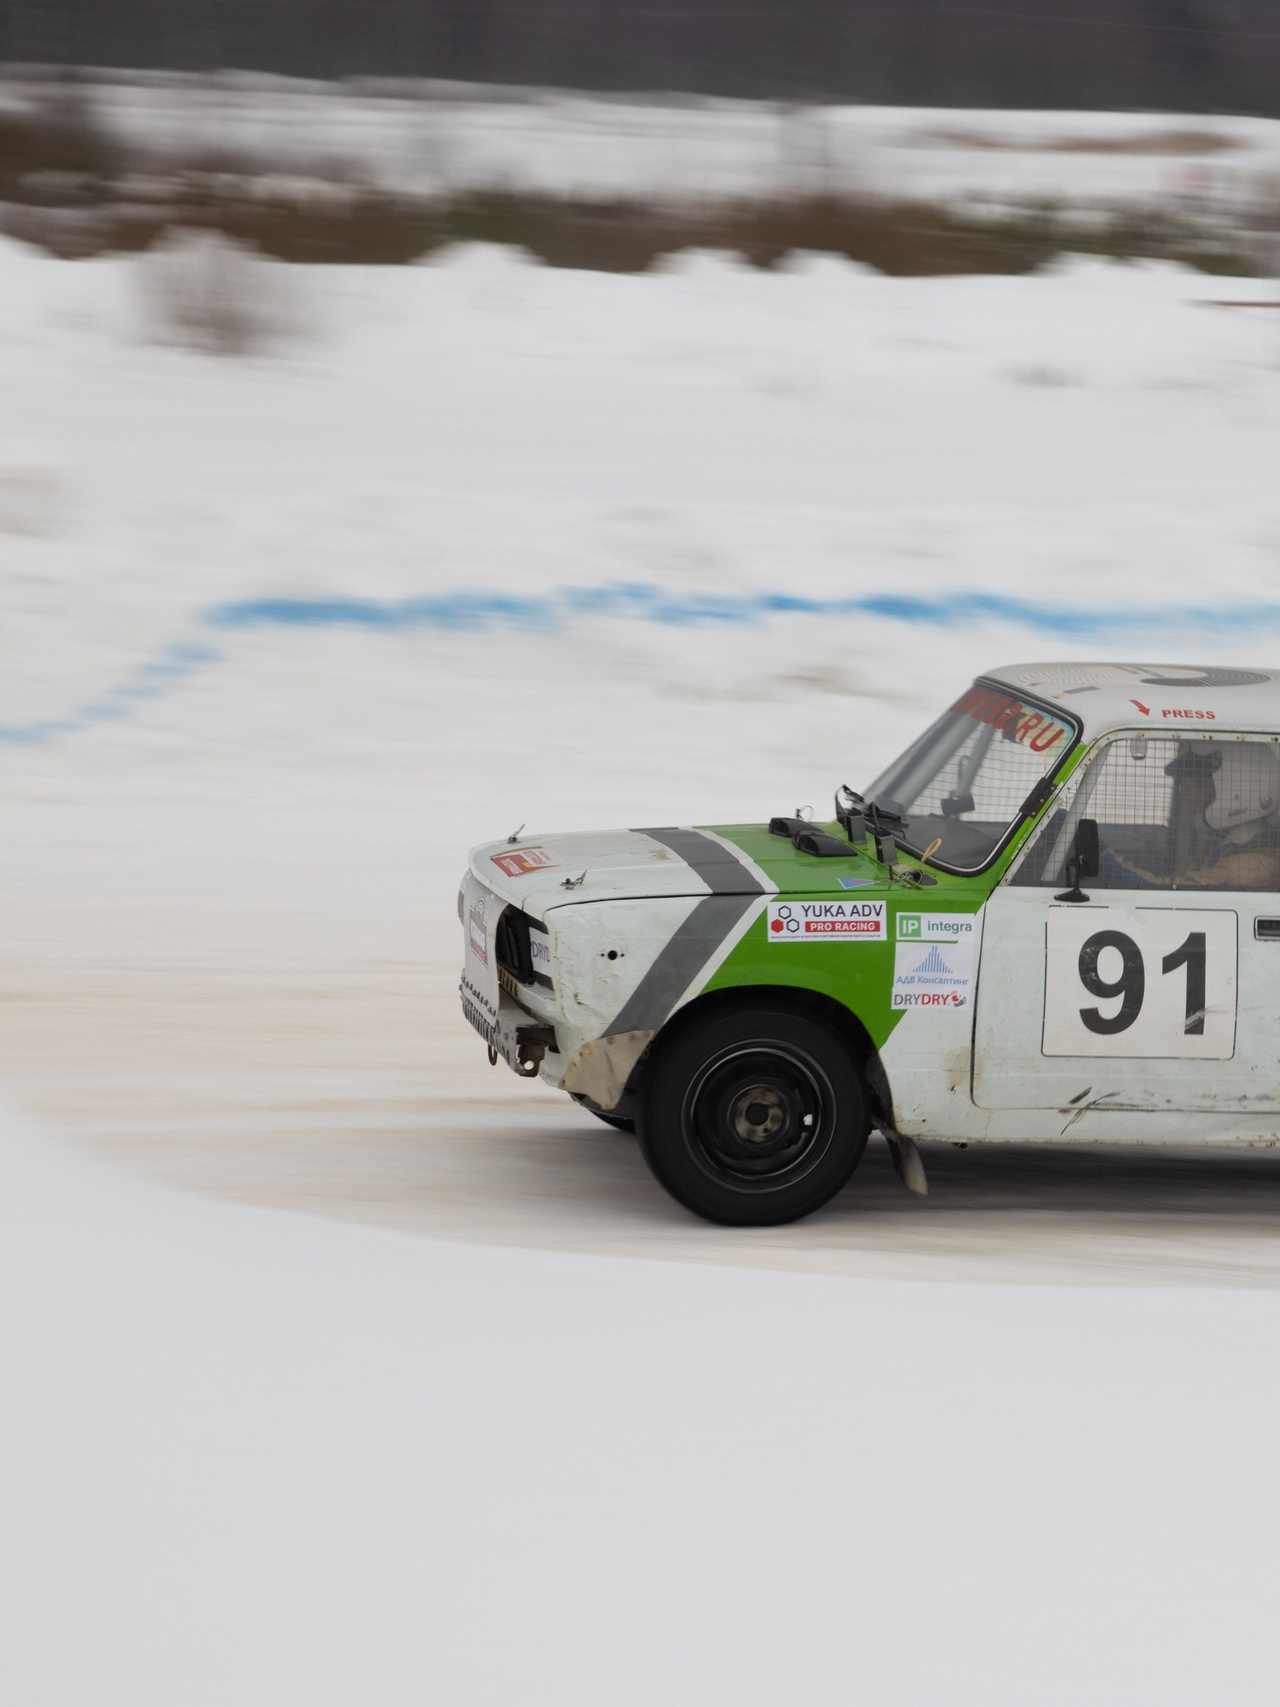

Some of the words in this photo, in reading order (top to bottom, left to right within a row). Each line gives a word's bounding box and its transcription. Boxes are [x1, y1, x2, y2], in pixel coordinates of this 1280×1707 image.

[1161, 709, 1216, 720] PRESS
[801, 904, 847, 918] YUKA
[850, 904, 884, 917] ADV
[810, 922, 832, 932] PRO
[835, 922, 876, 931] RACING
[902, 919, 919, 934] IP
[927, 920, 973, 933] integra
[896, 976, 915, 985] АДВ
[917, 975, 969, 986] Консалтинг
[1078, 929, 1207, 1036] 91
[893, 993, 949, 1006] DRYDRY
